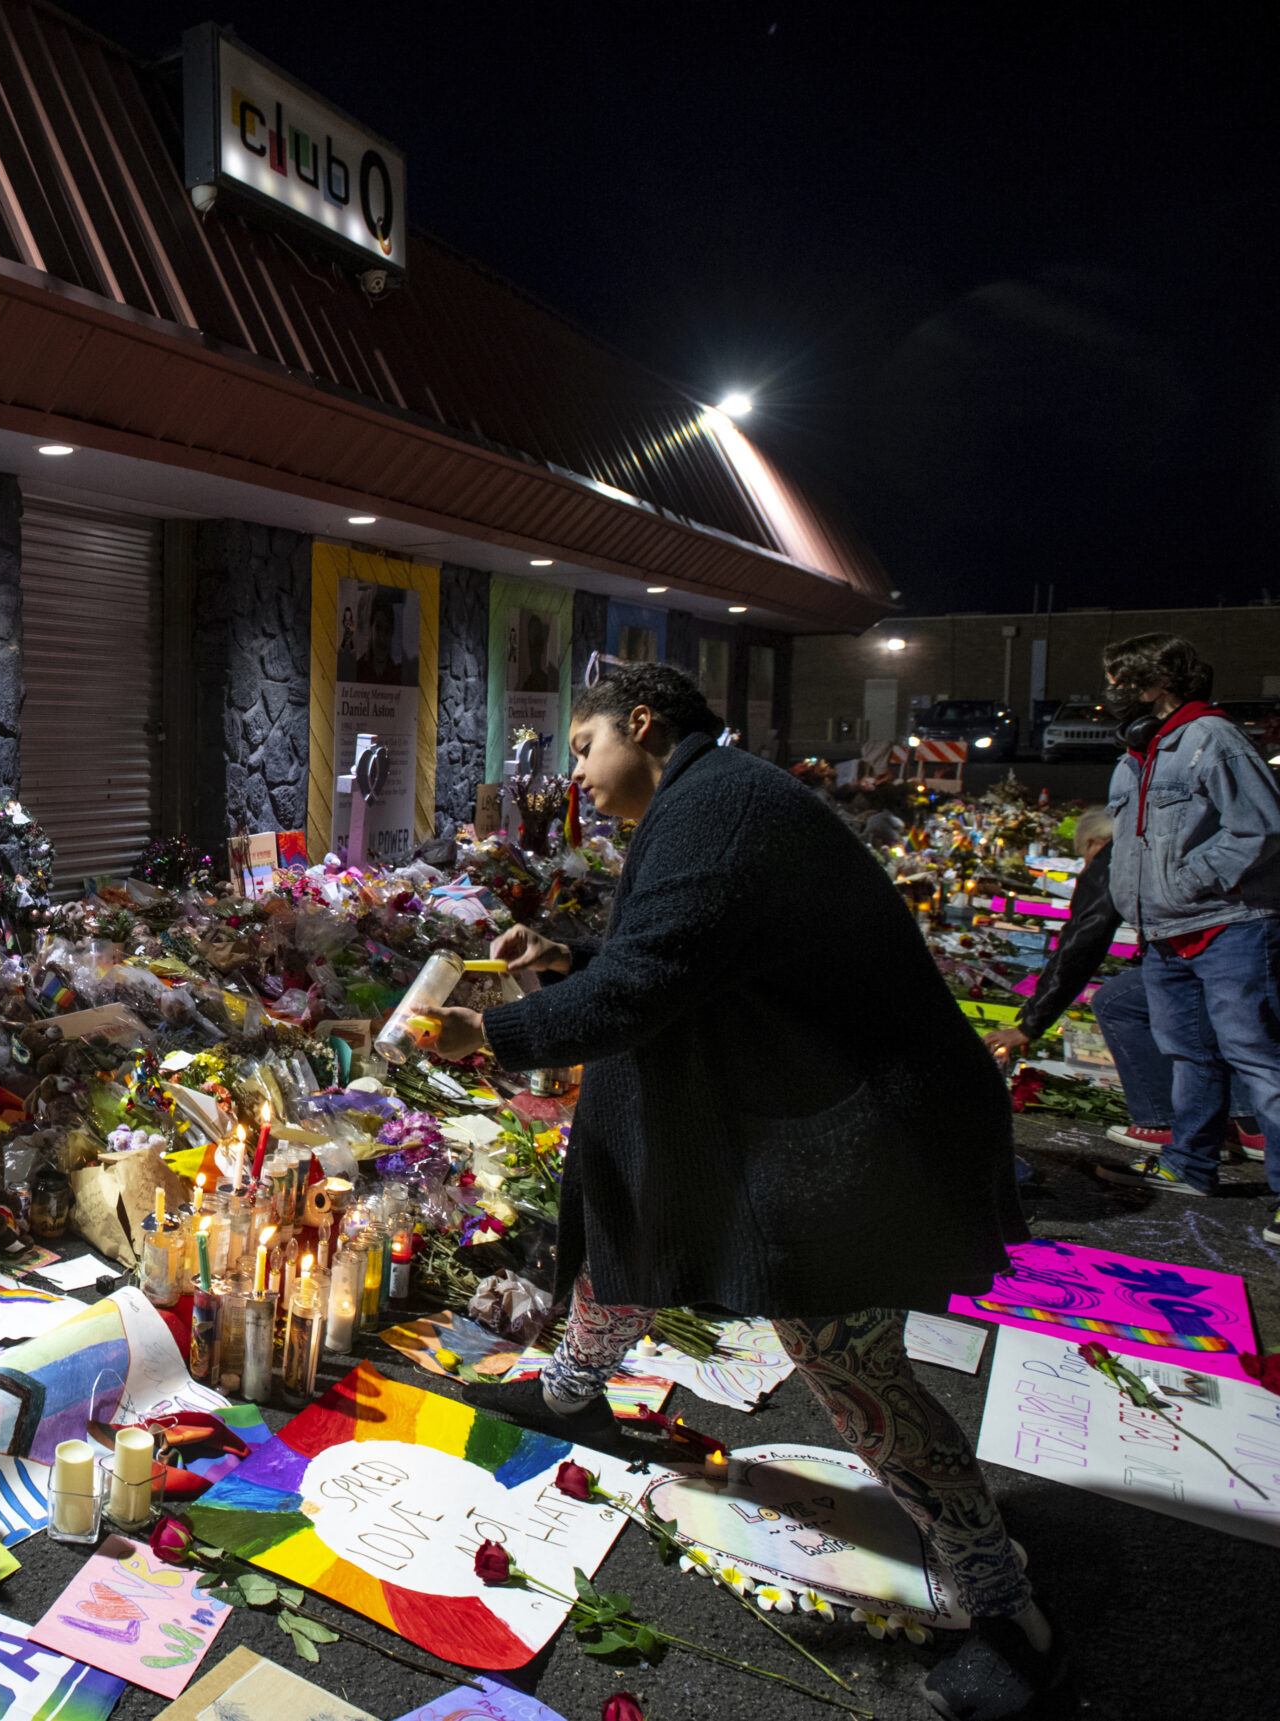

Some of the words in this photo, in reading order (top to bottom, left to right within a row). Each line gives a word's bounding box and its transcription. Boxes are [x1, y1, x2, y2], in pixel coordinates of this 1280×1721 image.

[240, 101, 350, 206] club
[360, 149, 393, 255] Q
[341, 701, 370, 717] Daniel
[372, 704, 396, 718] Aston
[377, 828, 410, 854] POWER
[1015, 1380, 1090, 1467] TAKE
[770, 1451, 842, 1466] Acceptance
[345, 1500, 445, 1572] LOVE
[525, 1481, 584, 1548] HAT
